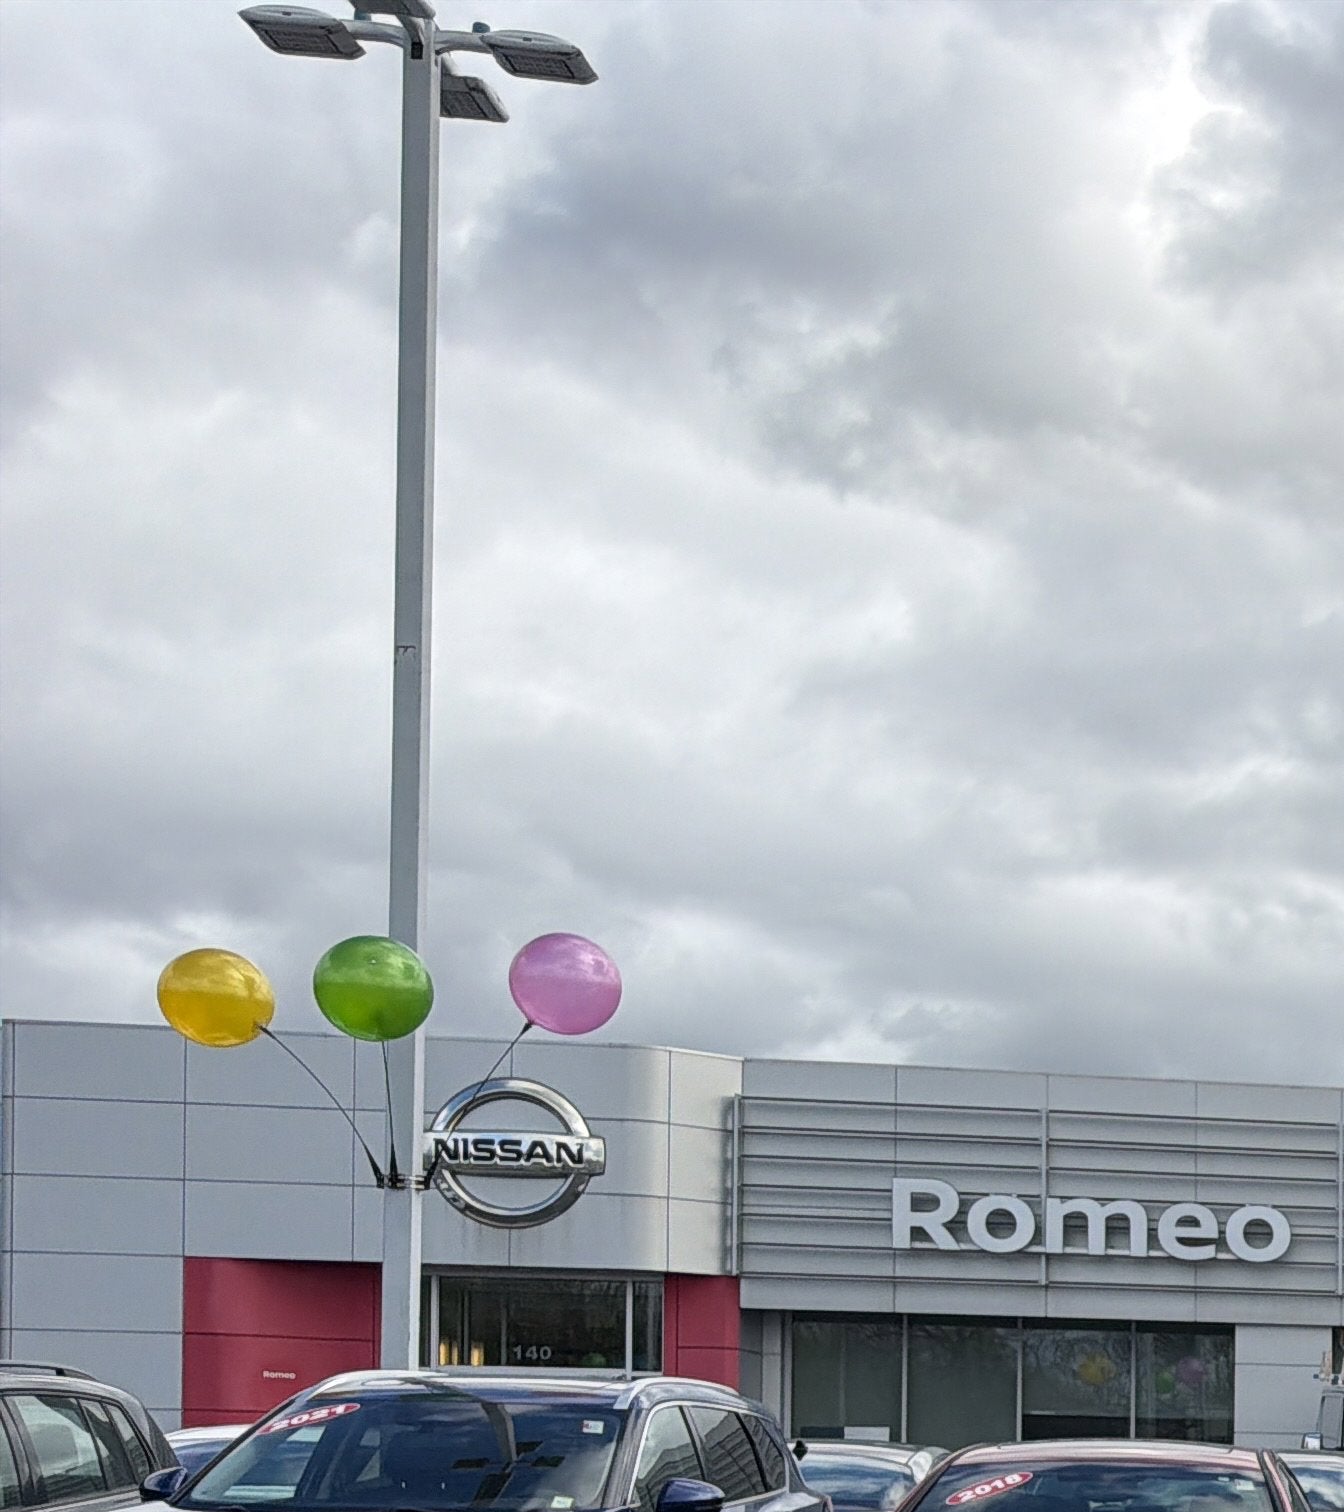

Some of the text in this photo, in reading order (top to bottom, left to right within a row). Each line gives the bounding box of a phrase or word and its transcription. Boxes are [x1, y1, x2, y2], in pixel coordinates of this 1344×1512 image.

[433, 1137, 585, 1168] NISSAN
[892, 1177, 1292, 1263] Romeo
[512, 1345, 552, 1361] 140
[262, 1370, 296, 1380] Romeo
[269, 1404, 346, 1432] 2021
[957, 1473, 1023, 1503] 2018
